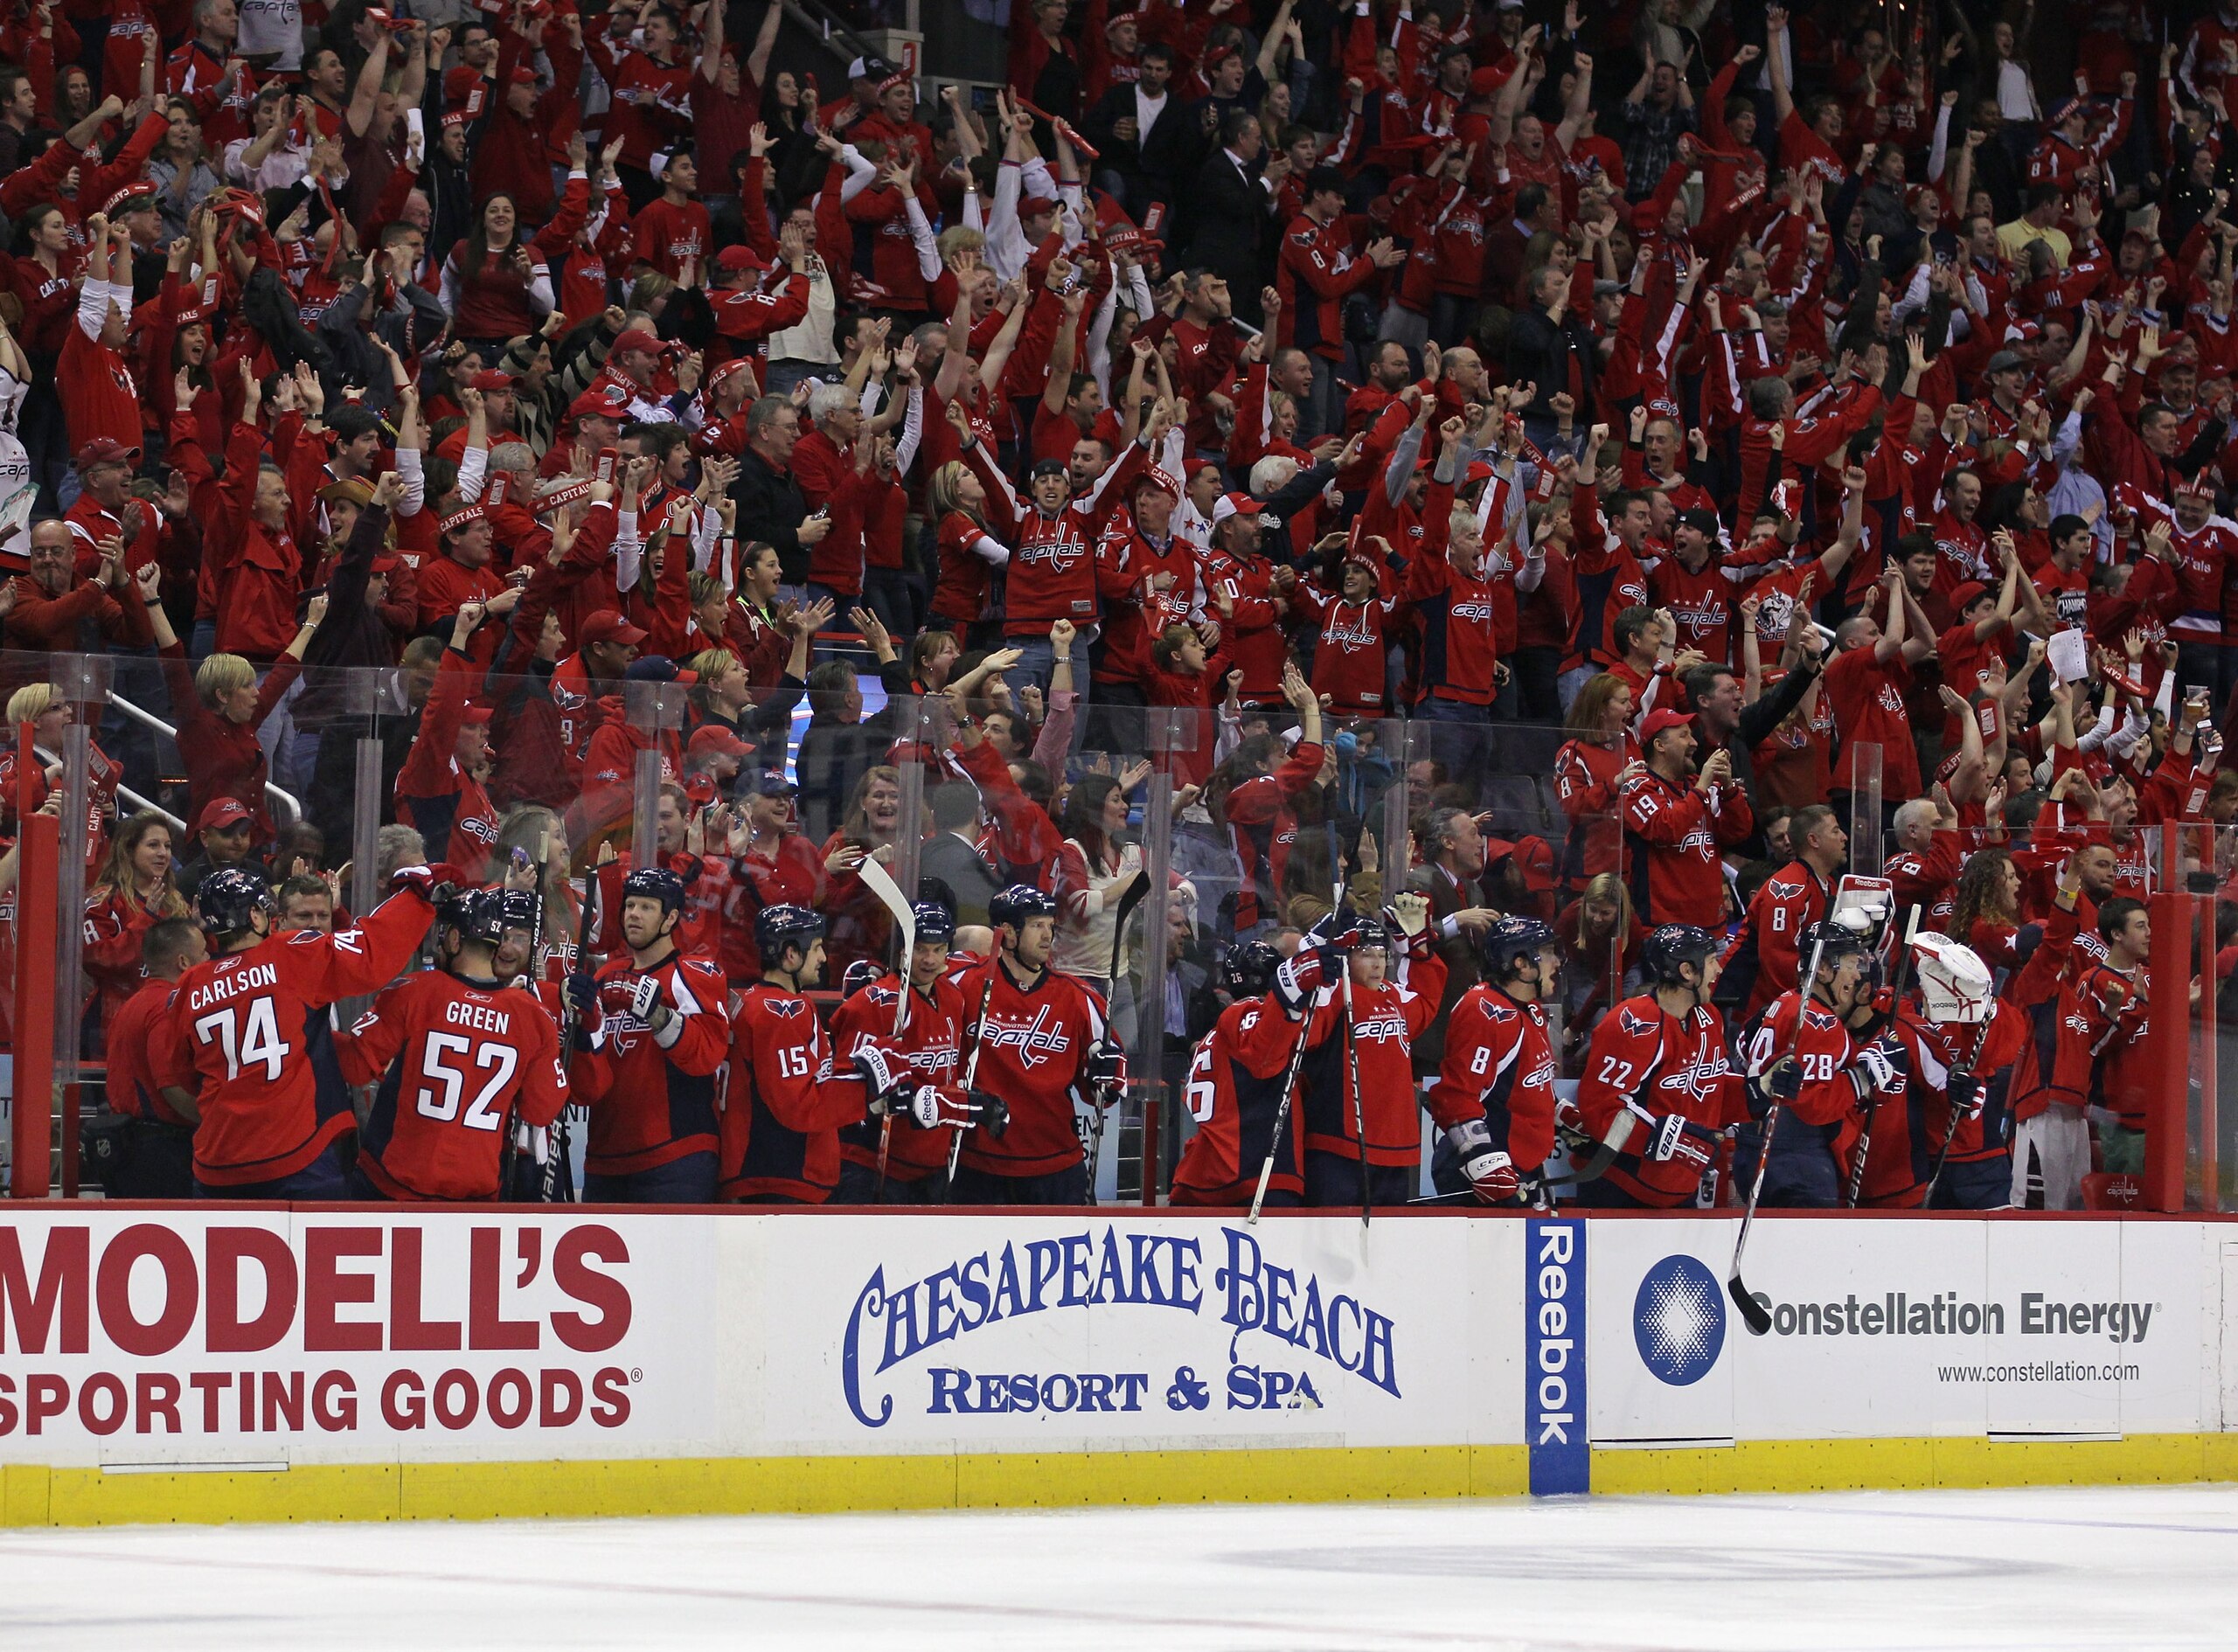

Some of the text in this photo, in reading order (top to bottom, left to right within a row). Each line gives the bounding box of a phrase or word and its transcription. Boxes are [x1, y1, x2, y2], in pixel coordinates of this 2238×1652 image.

[440, 504, 484, 531] CAPITALS
[2209, 531, 2221, 544] A
[1560, 777, 1573, 799] 8
[1631, 795, 1659, 824] 19
[1901, 860, 1921, 875] 8
[490, 920, 502, 934] 52
[1773, 907, 1787, 932] 8
[333, 929, 364, 954] 74
[191, 962, 278, 1010] CARLSON
[445, 1001, 510, 1035] GREEN
[1527, 1004, 1544, 1028] C
[1694, 1006, 1713, 1030] A
[195, 996, 290, 1082] 74
[778, 1045, 808, 1079] 15
[1470, 1046, 1491, 1075] 8
[1597, 1054, 1633, 1090] 22
[1803, 1053, 1833, 1081] 28
[422, 1030, 518, 1133] 52
[922, 1085, 933, 1121] Reebok
[1478, 1154, 1506, 1170] CCM
[0, 1225, 633, 1357] MODELL'S
[842, 1225, 1402, 1428] CHESAPEAKE BEACH
[1538, 1225, 1574, 1446] Reebok
[1937, 1360, 2140, 1383] www.constellation.com
[926, 1364, 1324, 1414] RESORT & SPA
